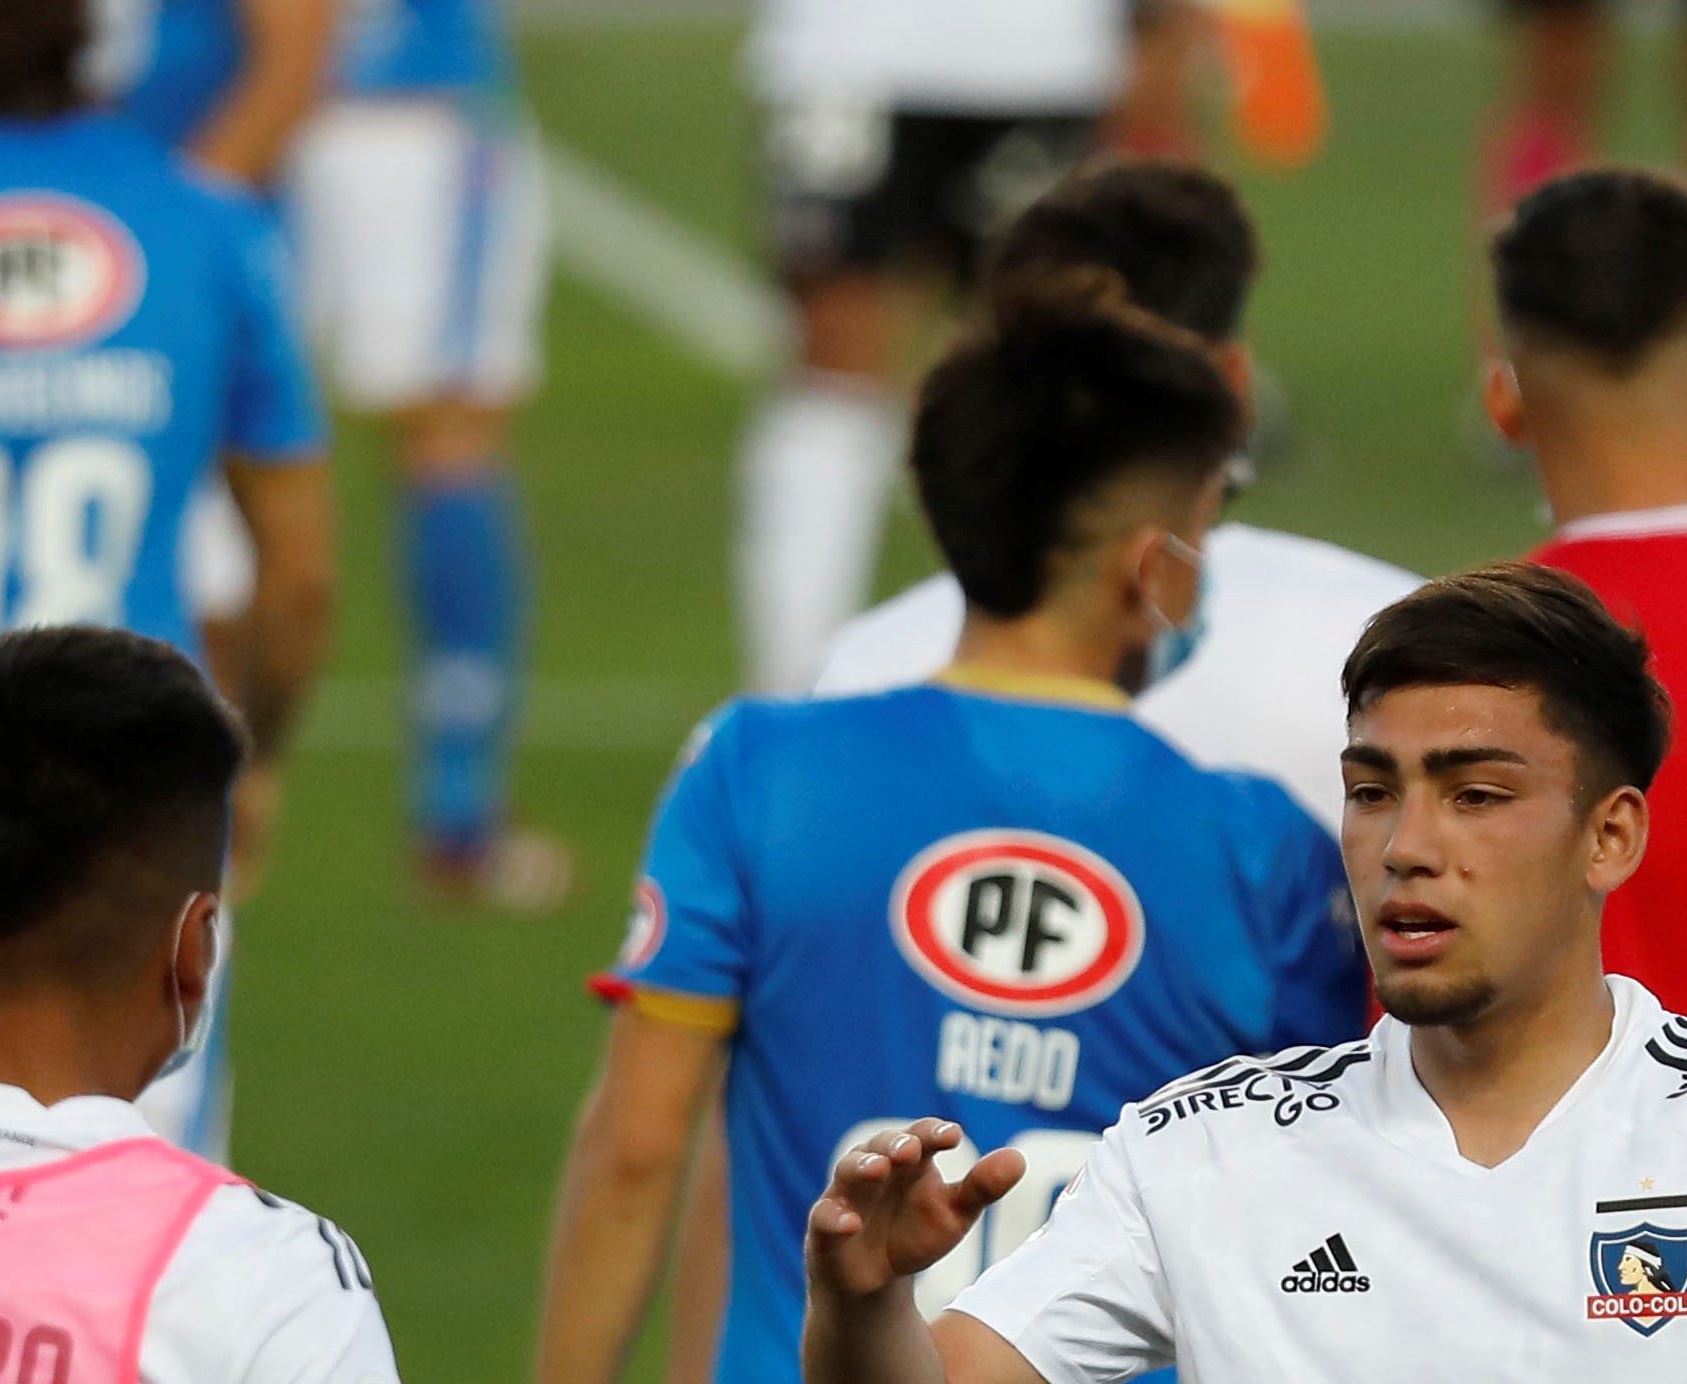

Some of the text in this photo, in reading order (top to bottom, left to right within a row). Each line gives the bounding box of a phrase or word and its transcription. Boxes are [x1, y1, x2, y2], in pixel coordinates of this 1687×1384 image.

[961, 873, 1082, 975] PF
[1274, 1092, 1340, 1127] GO
[1280, 1271, 1371, 1294] adidas
